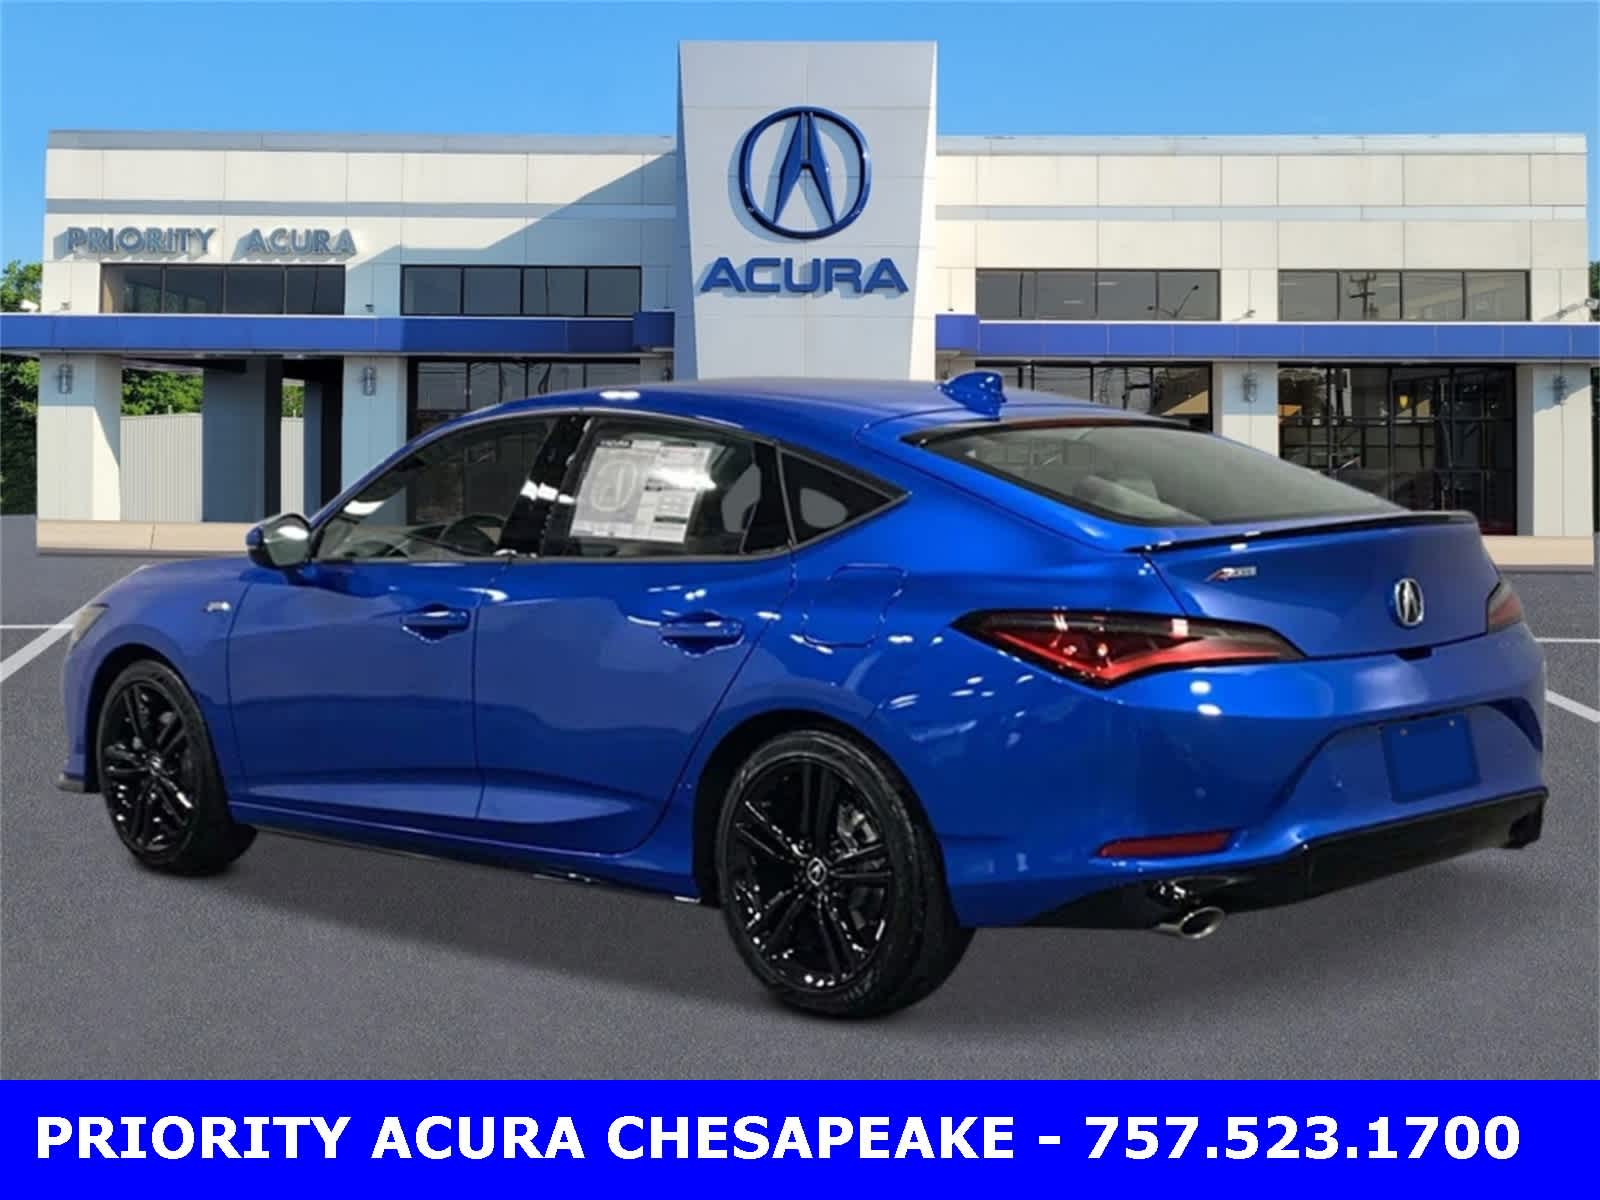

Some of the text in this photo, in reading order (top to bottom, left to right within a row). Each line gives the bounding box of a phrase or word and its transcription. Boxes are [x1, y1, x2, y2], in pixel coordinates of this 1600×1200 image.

[66, 226, 357, 255] PRIORITY ACURA
[700, 257, 909, 294] ACURA
